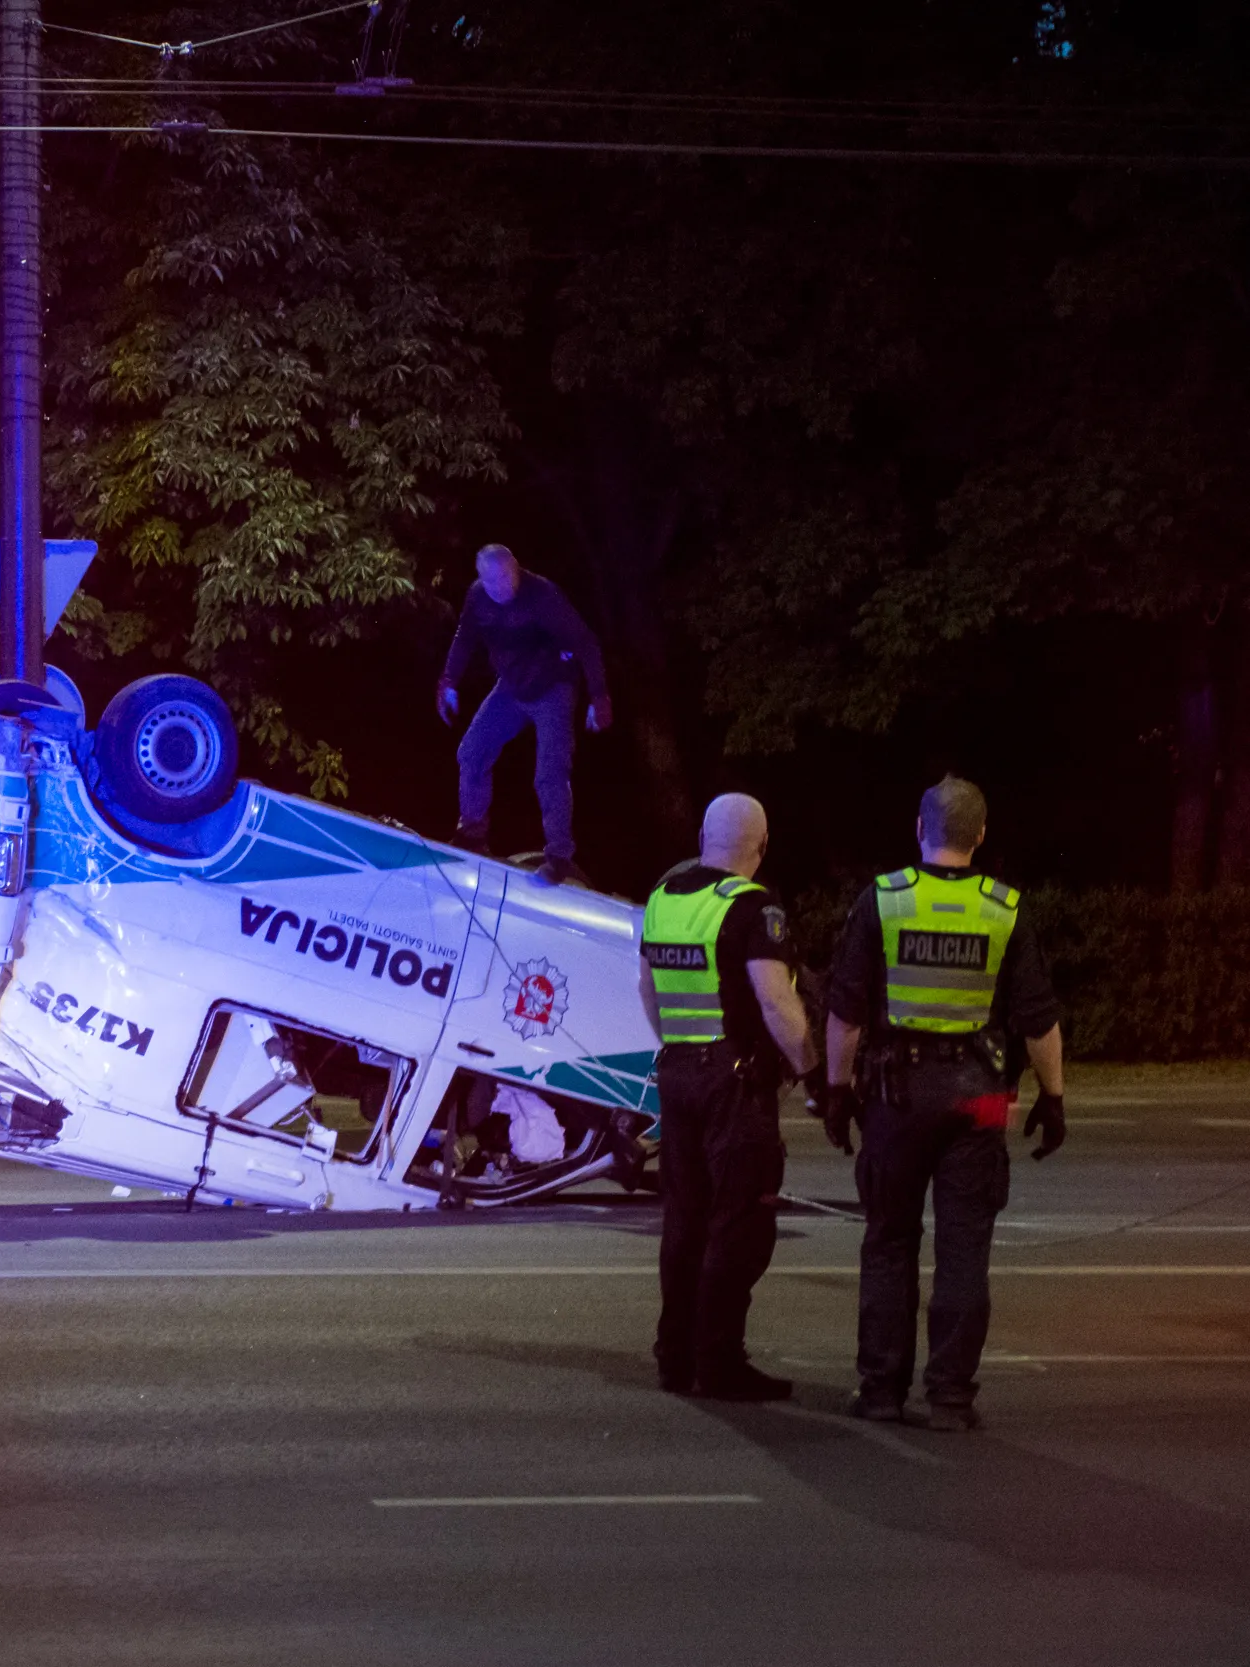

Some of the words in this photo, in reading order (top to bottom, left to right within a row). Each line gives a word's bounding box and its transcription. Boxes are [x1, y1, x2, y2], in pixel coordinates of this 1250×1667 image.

[240, 896, 454, 999] POLICIJA
[903, 934, 981, 964] POLICIJA
[30, 981, 154, 1056] K1735
